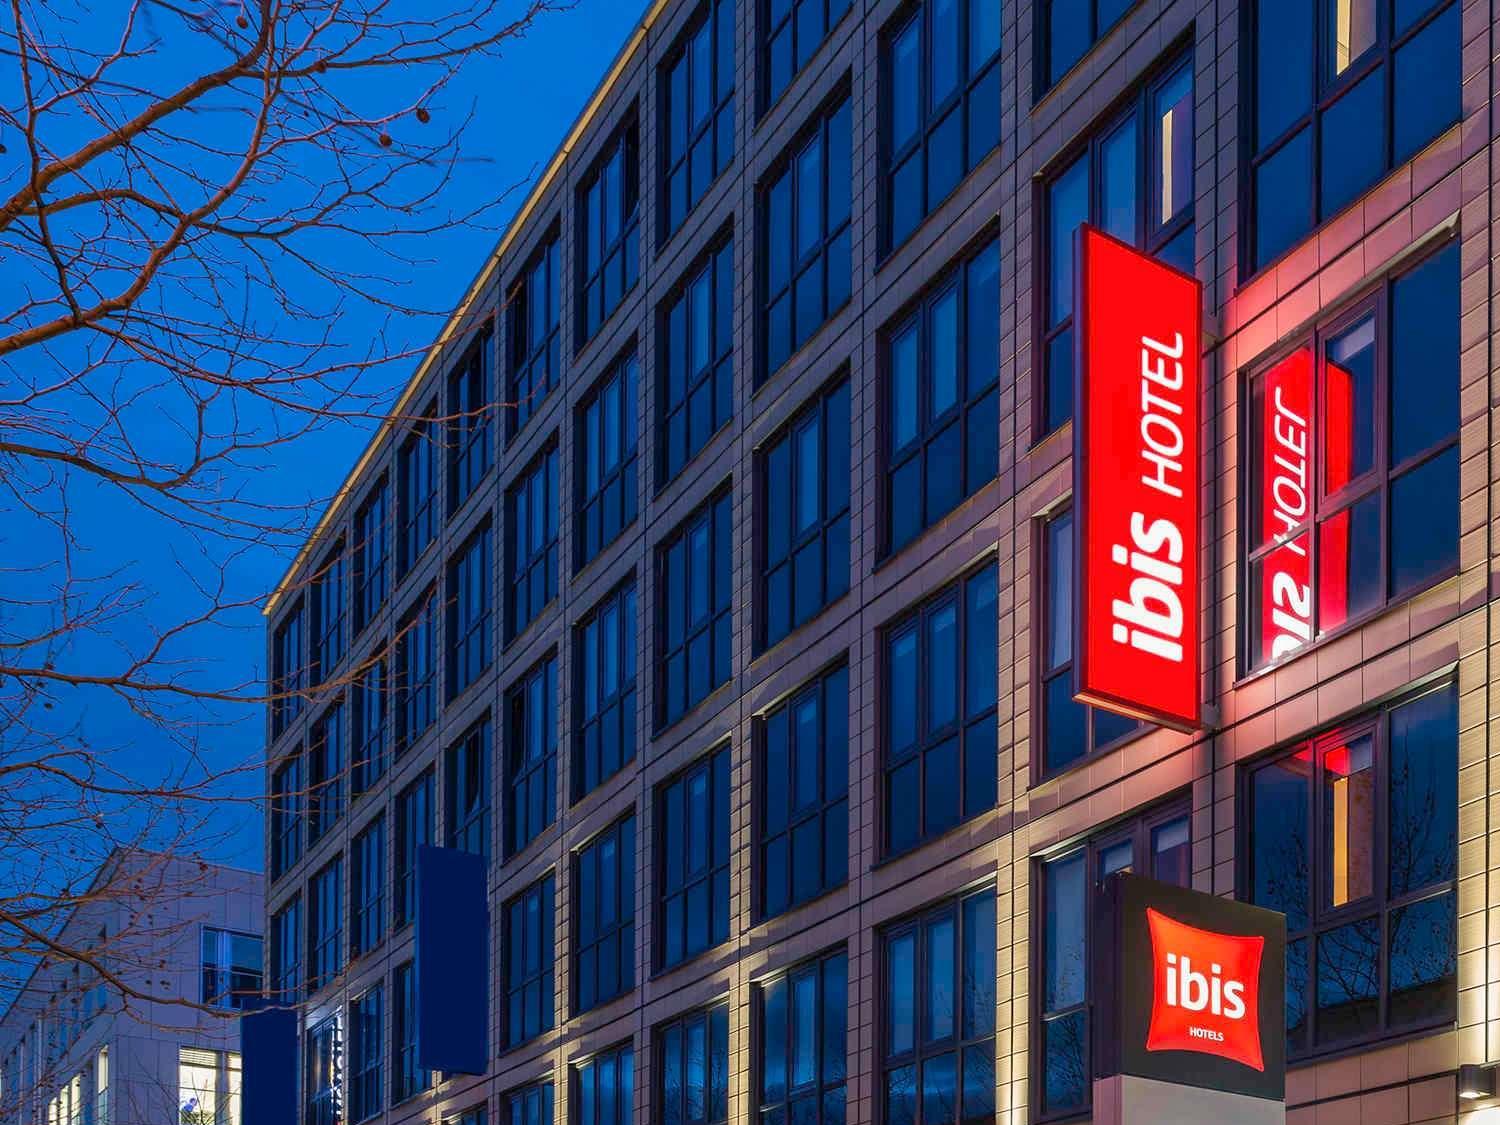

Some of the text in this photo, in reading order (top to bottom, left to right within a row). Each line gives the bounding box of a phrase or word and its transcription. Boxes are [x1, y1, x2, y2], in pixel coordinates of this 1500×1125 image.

[1111, 332, 1184, 663] ibis HOTEL
[1166, 952, 1246, 1020] ibis
[1189, 1026, 1225, 1042] HOTELS
